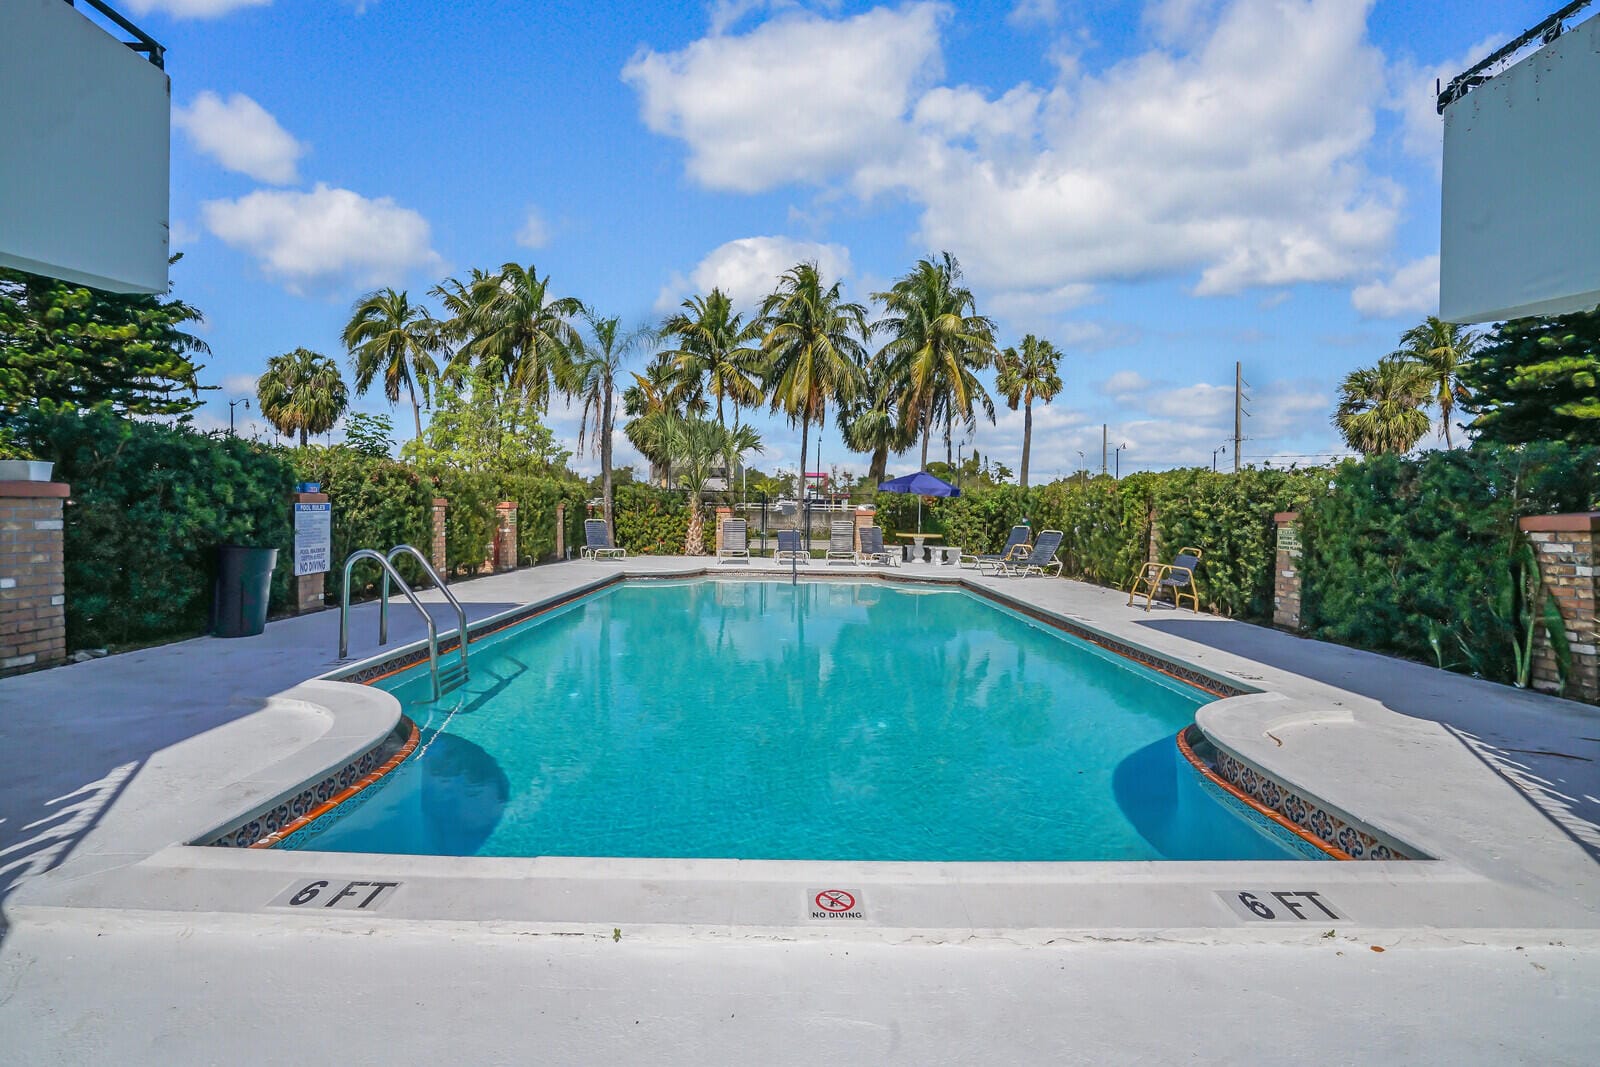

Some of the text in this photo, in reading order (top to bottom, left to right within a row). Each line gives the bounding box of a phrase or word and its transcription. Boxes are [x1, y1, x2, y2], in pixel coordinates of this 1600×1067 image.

[300, 560, 326, 573] NO DIVING
[289, 880, 399, 908] 6 FT
[1238, 891, 1340, 920] 6 FT
